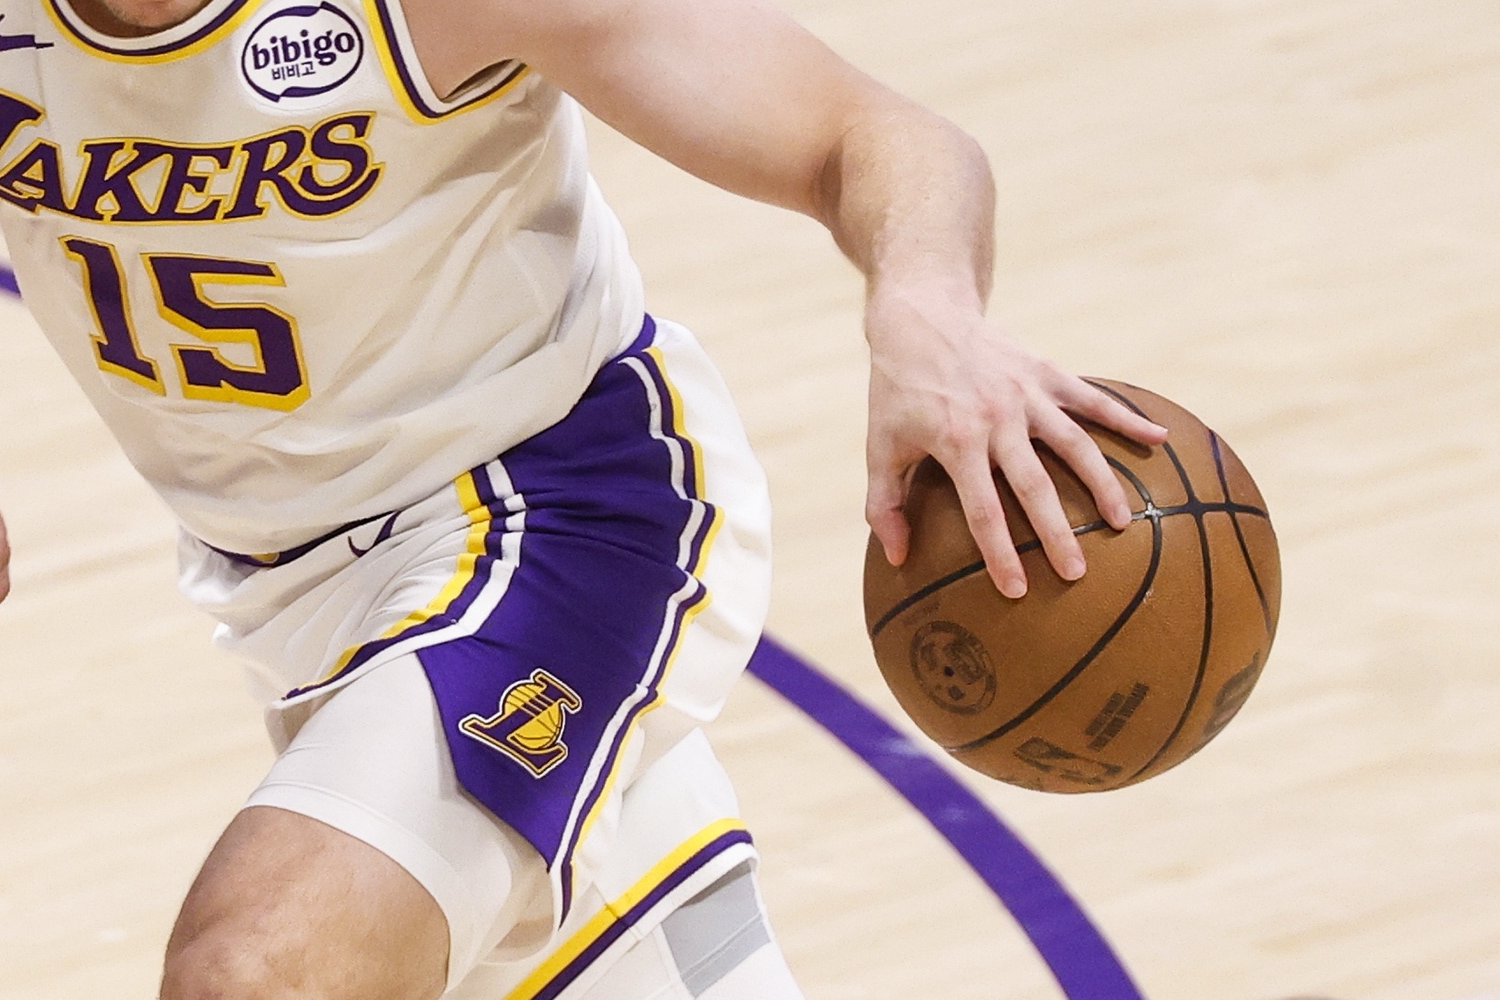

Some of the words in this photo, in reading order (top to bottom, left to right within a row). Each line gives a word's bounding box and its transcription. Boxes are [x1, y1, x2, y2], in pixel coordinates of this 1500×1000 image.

[251, 29, 355, 70] bibigo
[271, 61, 316, 80] 비비고
[58, 234, 311, 412] 15
